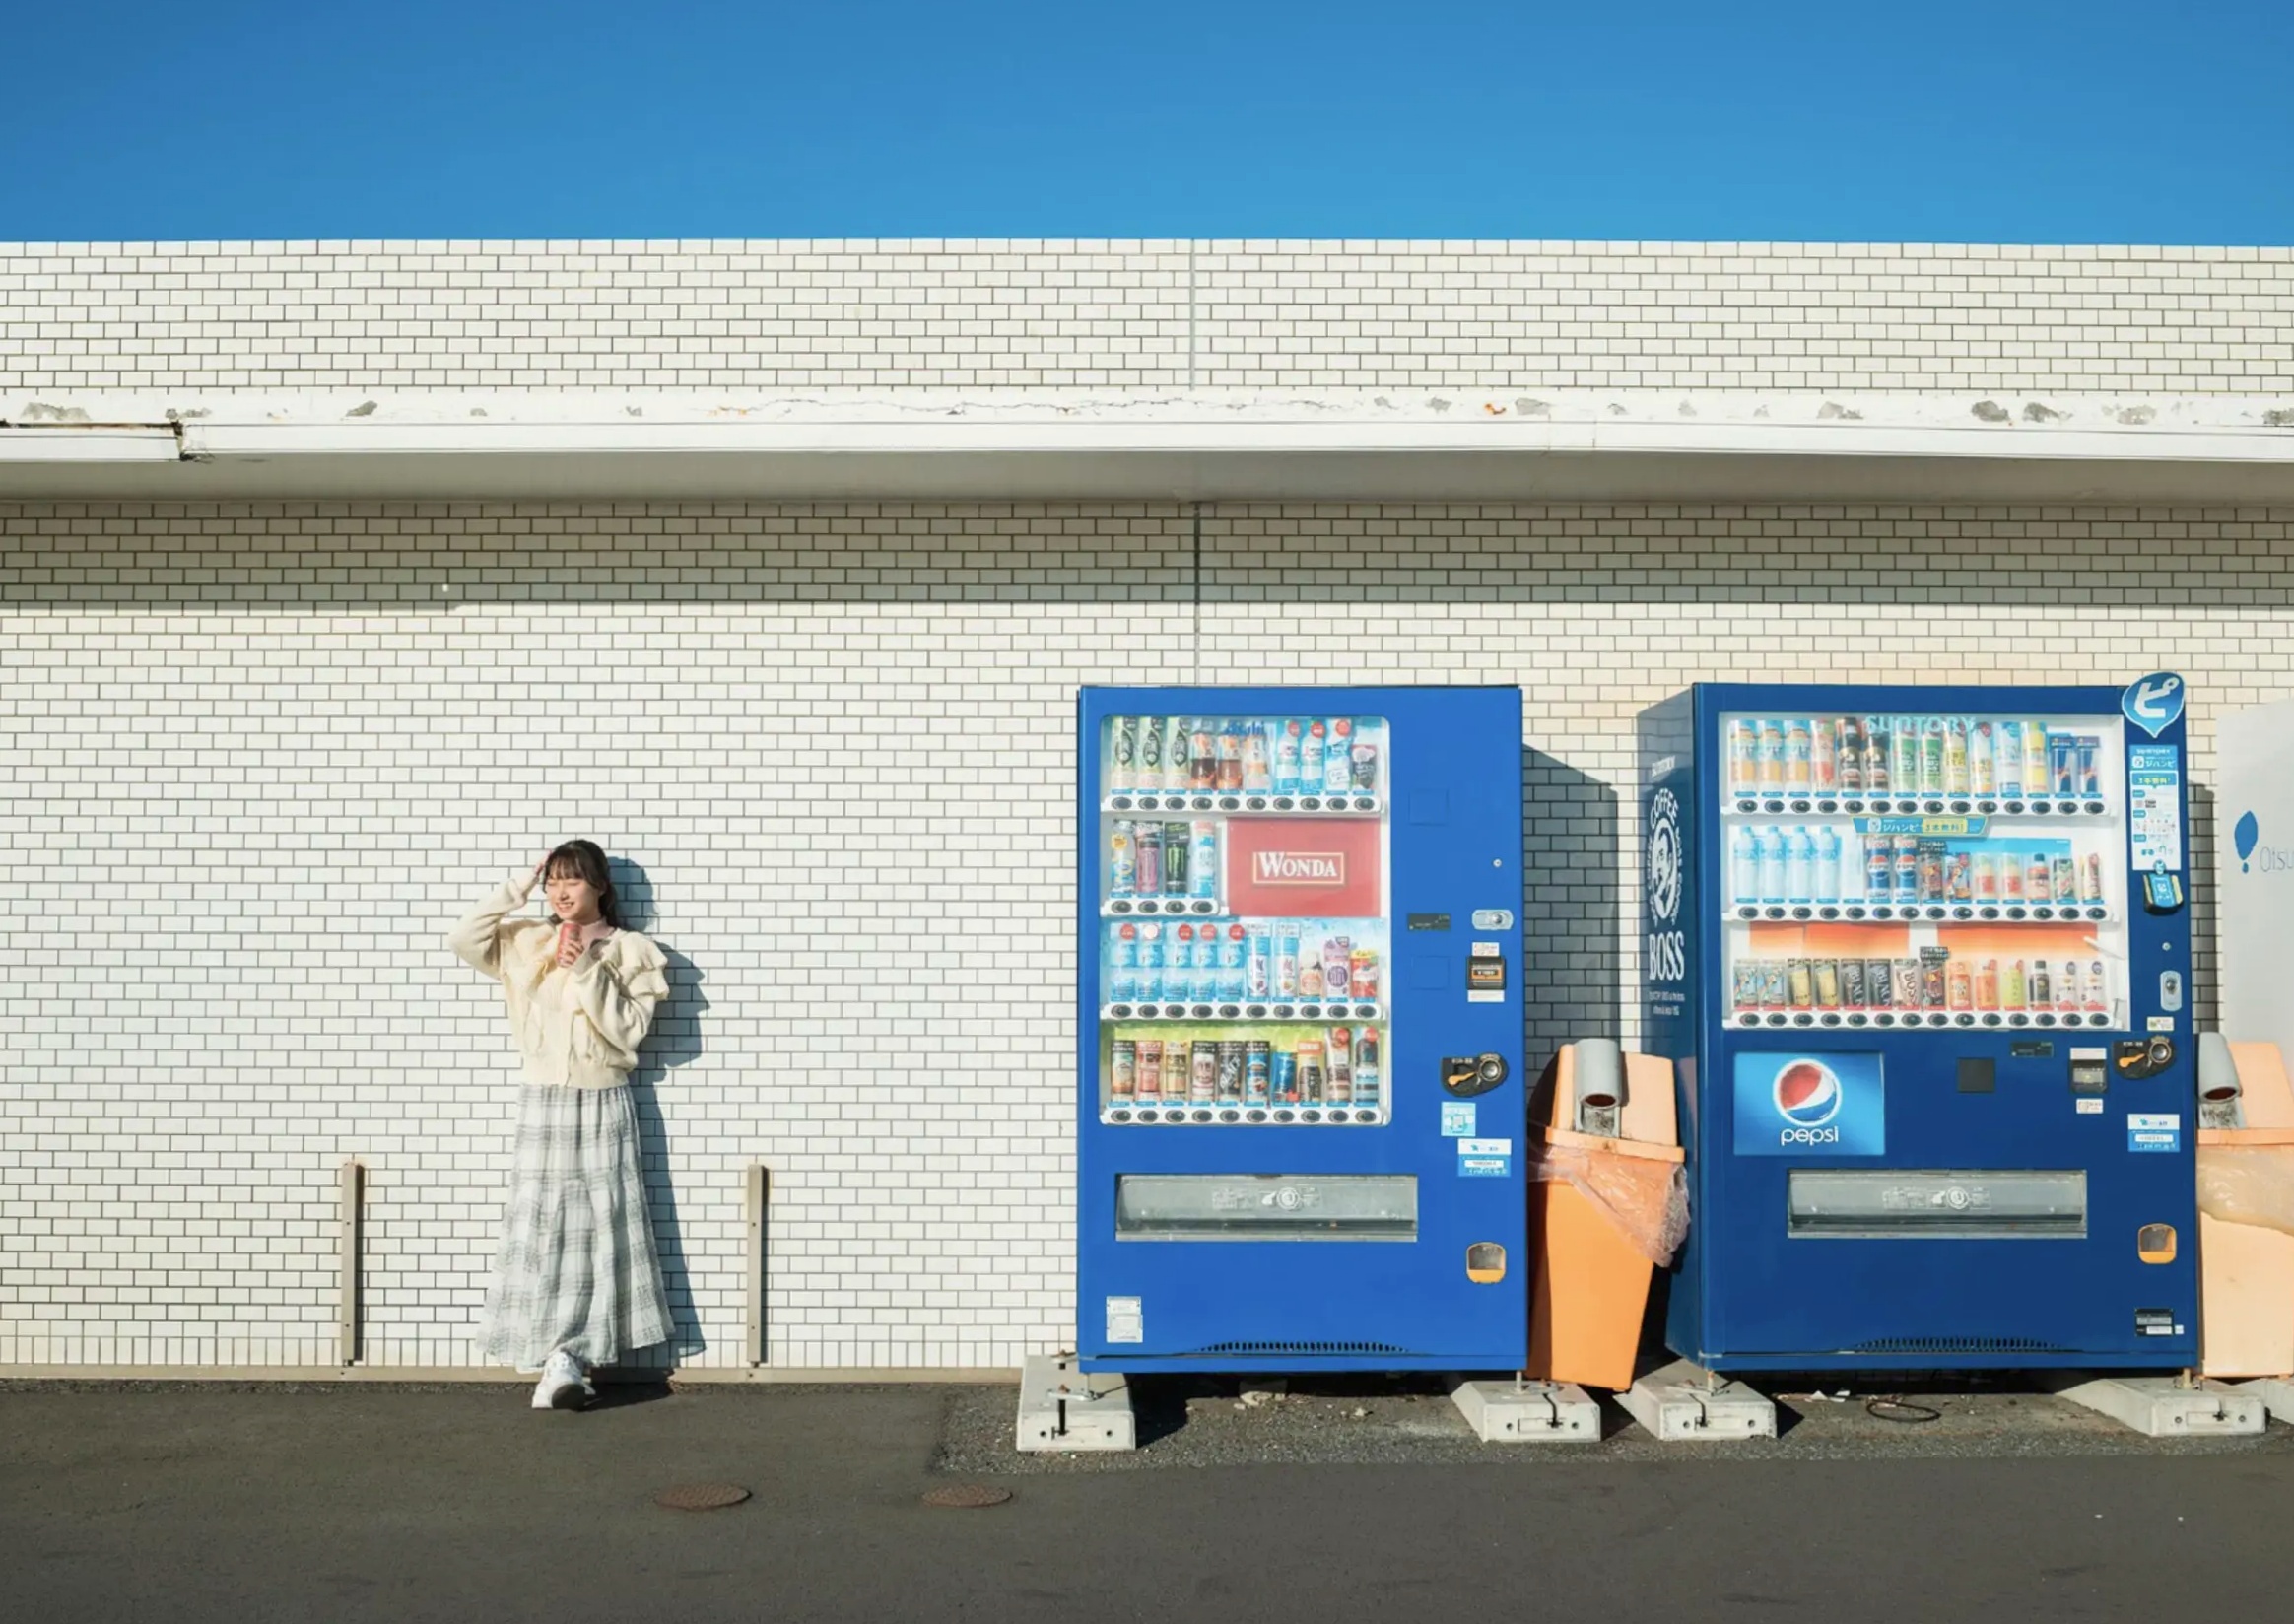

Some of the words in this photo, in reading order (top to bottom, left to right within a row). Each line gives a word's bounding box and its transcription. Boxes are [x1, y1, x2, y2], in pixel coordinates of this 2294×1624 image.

[1650, 787, 1679, 830] COFFEE
[1649, 931, 1685, 981] BOSS
[1781, 1125, 1839, 1146] pepsi
